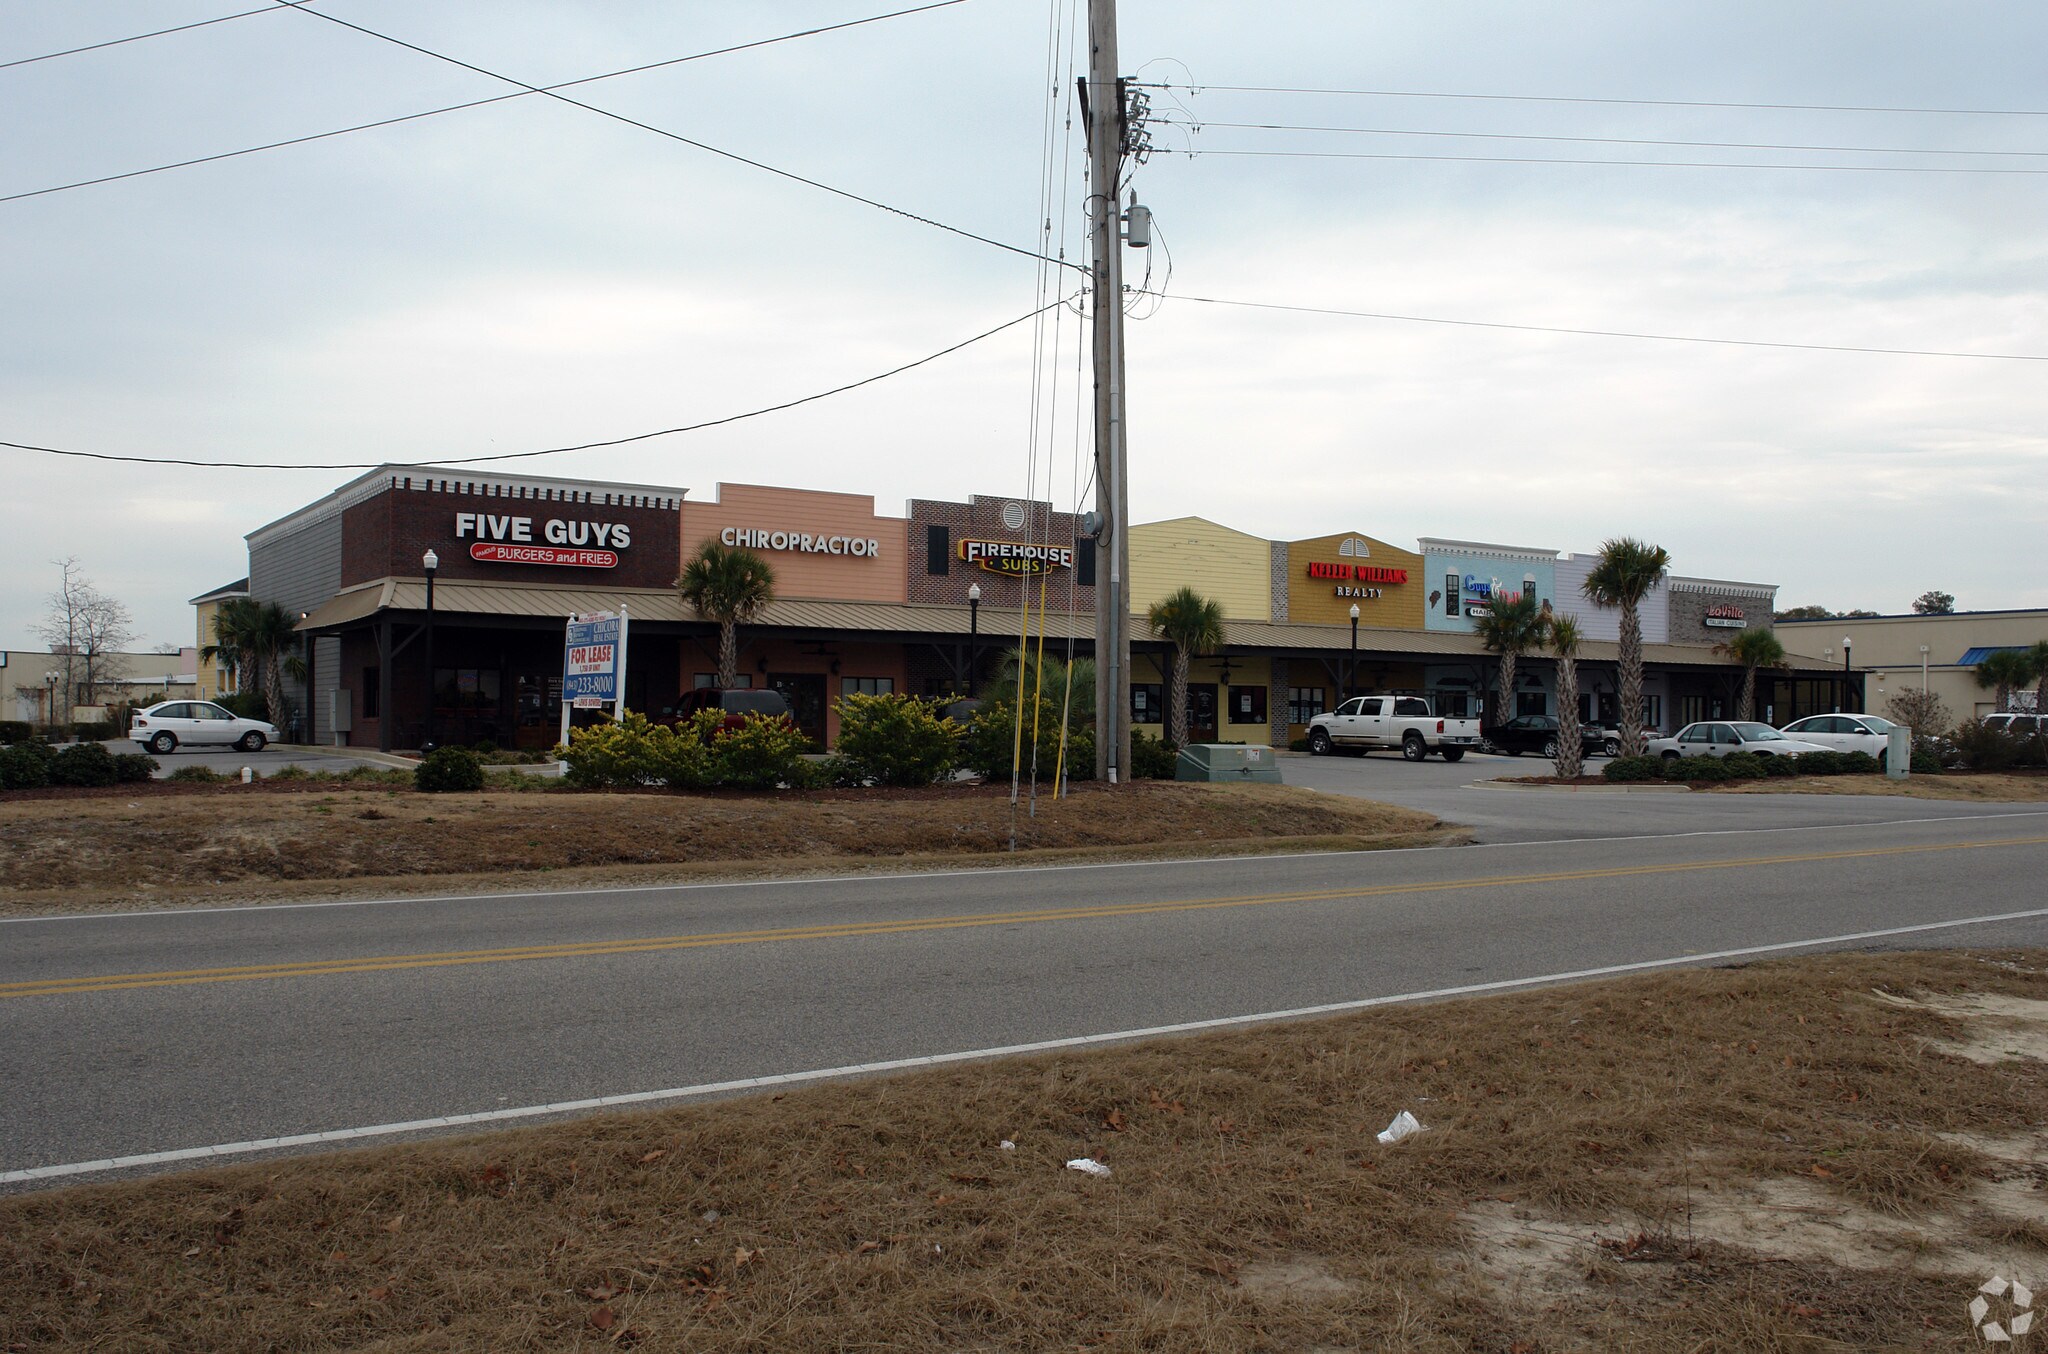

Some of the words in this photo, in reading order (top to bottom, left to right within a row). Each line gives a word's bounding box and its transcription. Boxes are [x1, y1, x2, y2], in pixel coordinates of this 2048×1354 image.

[456, 512, 532, 542] FIVE
[544, 518, 631, 549] GUYS
[720, 527, 879, 557] CHIROPRACTOR
[475, 546, 496, 558] FAMOUS
[497, 547, 554, 562] BURGERS
[556, 552, 577, 564] and
[579, 552, 612, 565] FRIES
[967, 542, 1072, 568] FIREHOUSE
[1002, 558, 1040, 572] SUBS
[1310, 562, 1352, 579] KELLER
[1356, 565, 1408, 584] WILLIAMS
[1336, 586, 1382, 598] REALTY
[1464, 574, 1490, 596] Guys
[593, 633, 603, 642] REAL
[604, 632, 619, 641] ESTATE
[571, 648, 586, 664] FOR
[588, 645, 611, 663] LEASE
[577, 676, 613, 692] 233-8000
